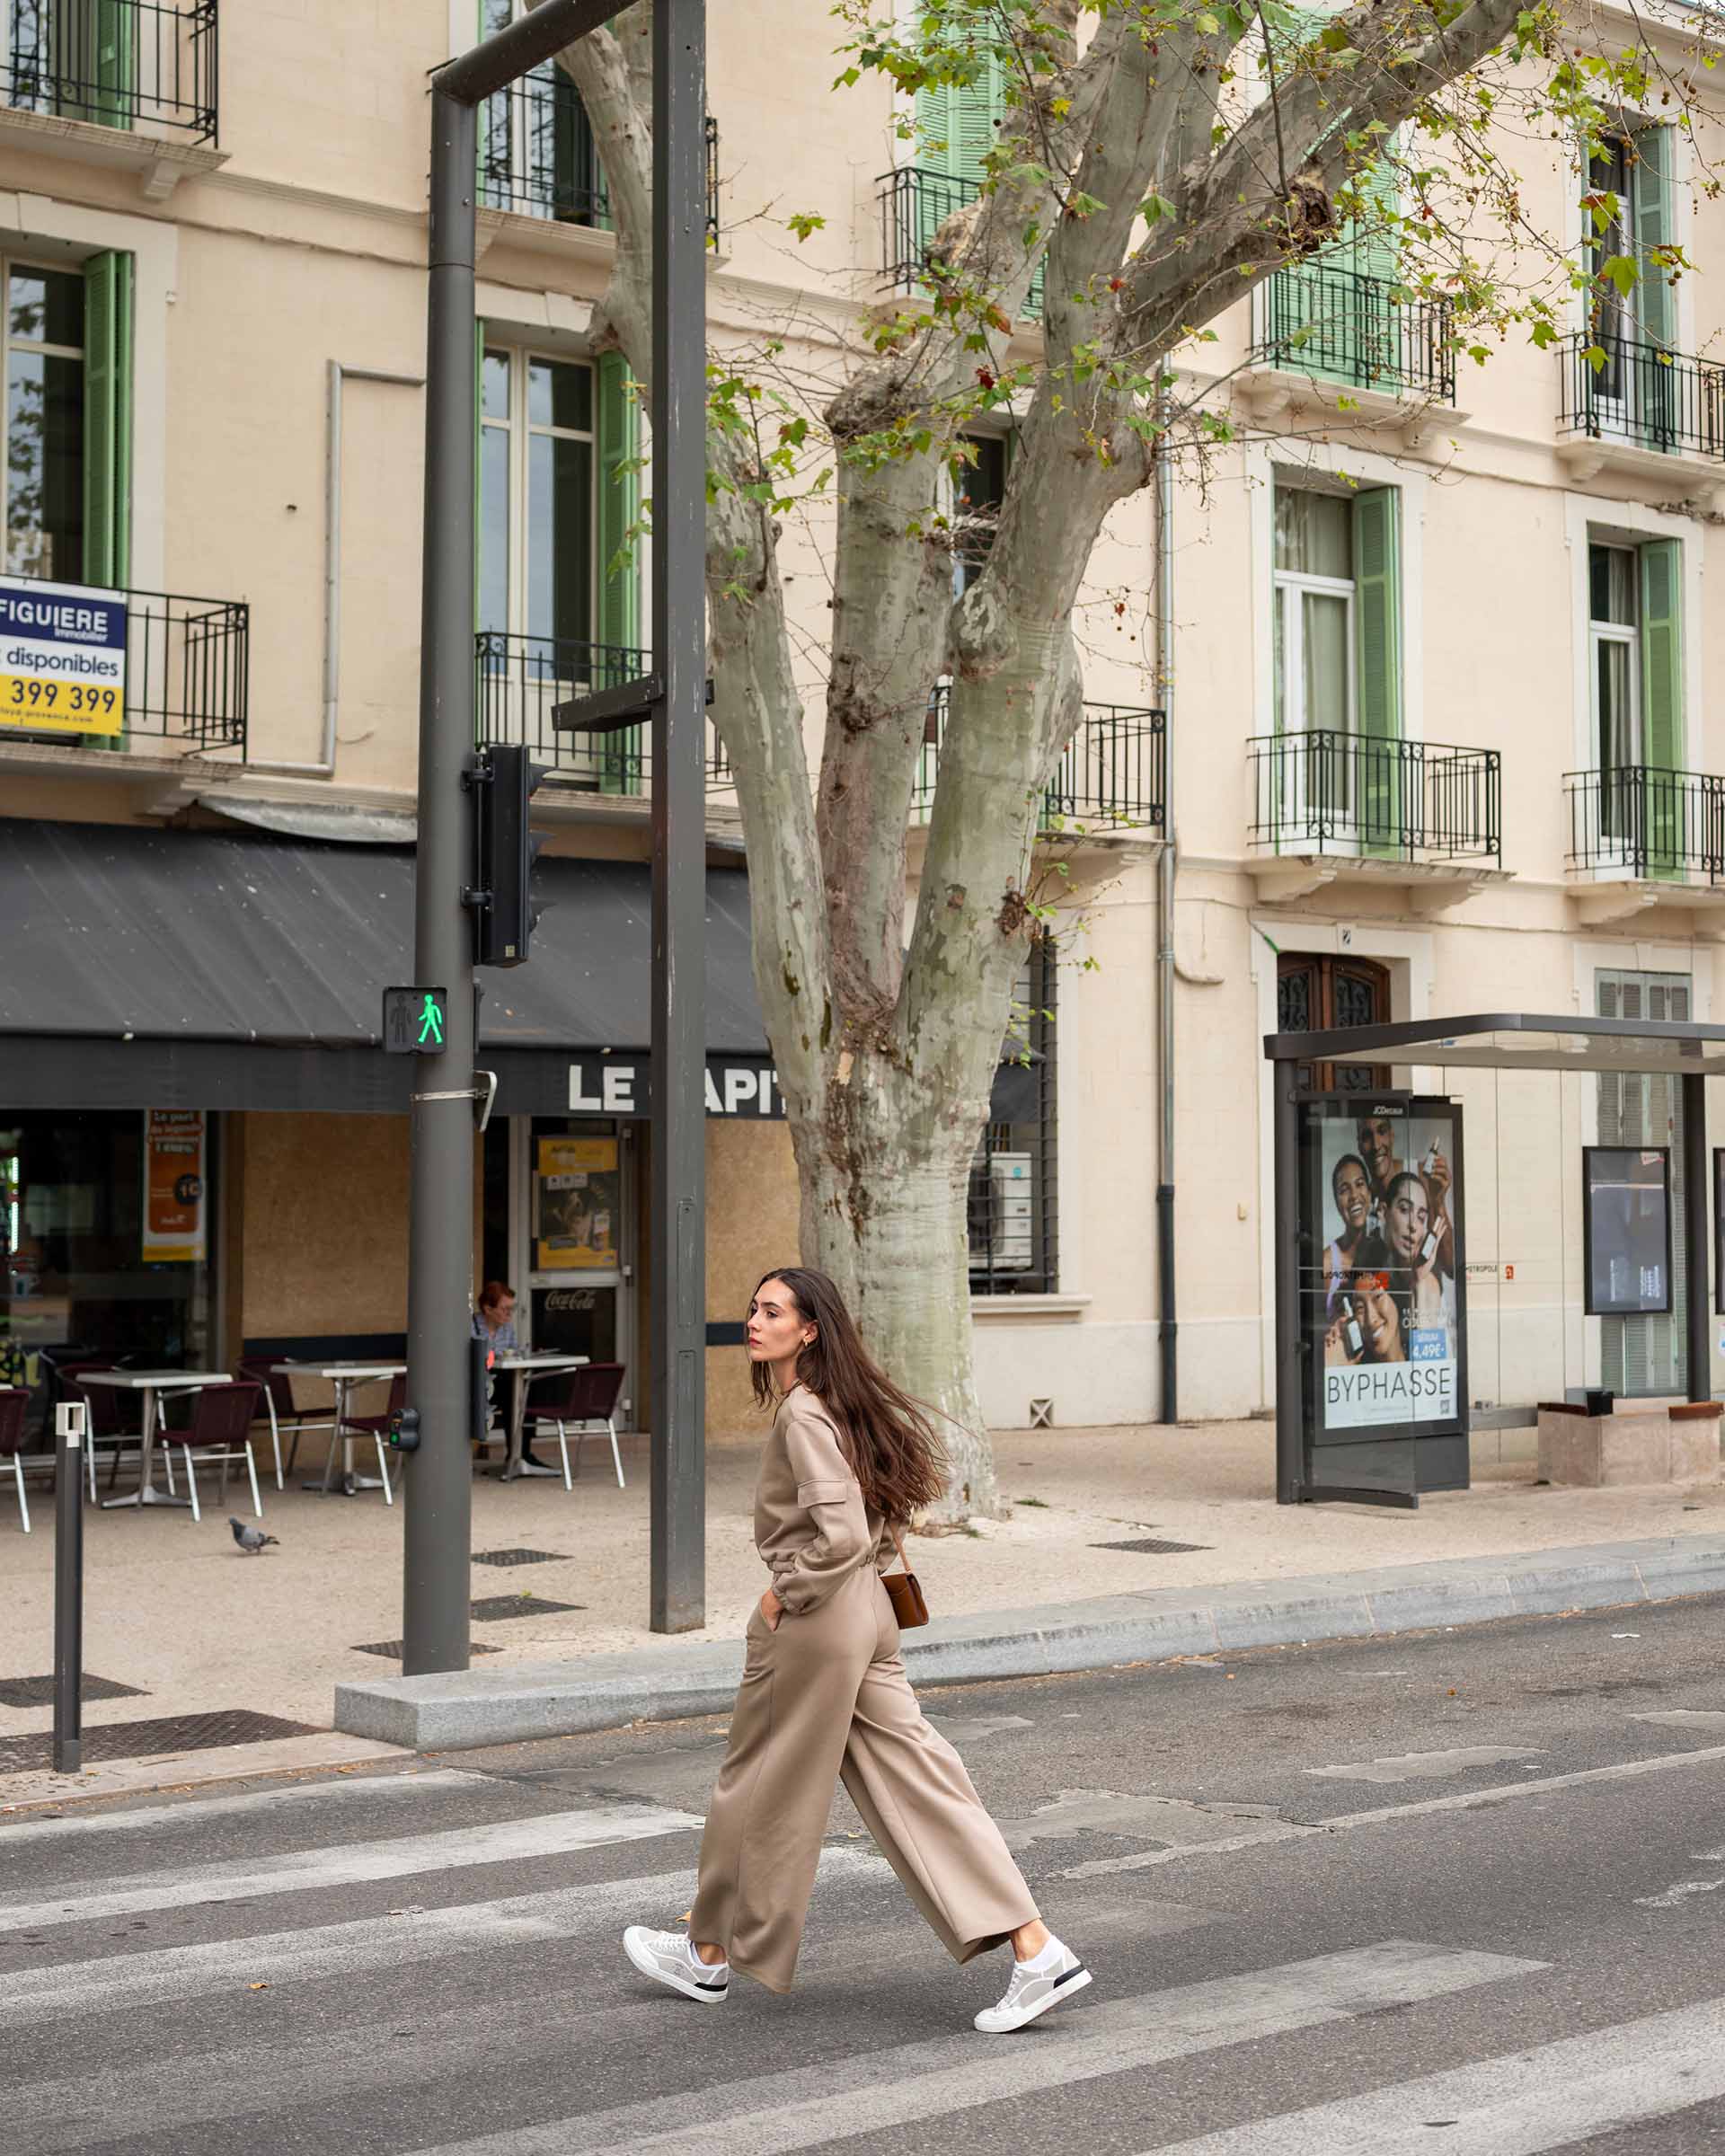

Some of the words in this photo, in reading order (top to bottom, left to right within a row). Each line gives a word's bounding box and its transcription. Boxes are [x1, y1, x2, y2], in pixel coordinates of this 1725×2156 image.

[6, 646, 118, 676] disponibles
[12, 679, 58, 708] 399
[70, 685, 116, 713] 399
[569, 1065, 635, 1112] LE
[1327, 1367, 1451, 1403] BYPHASSE
